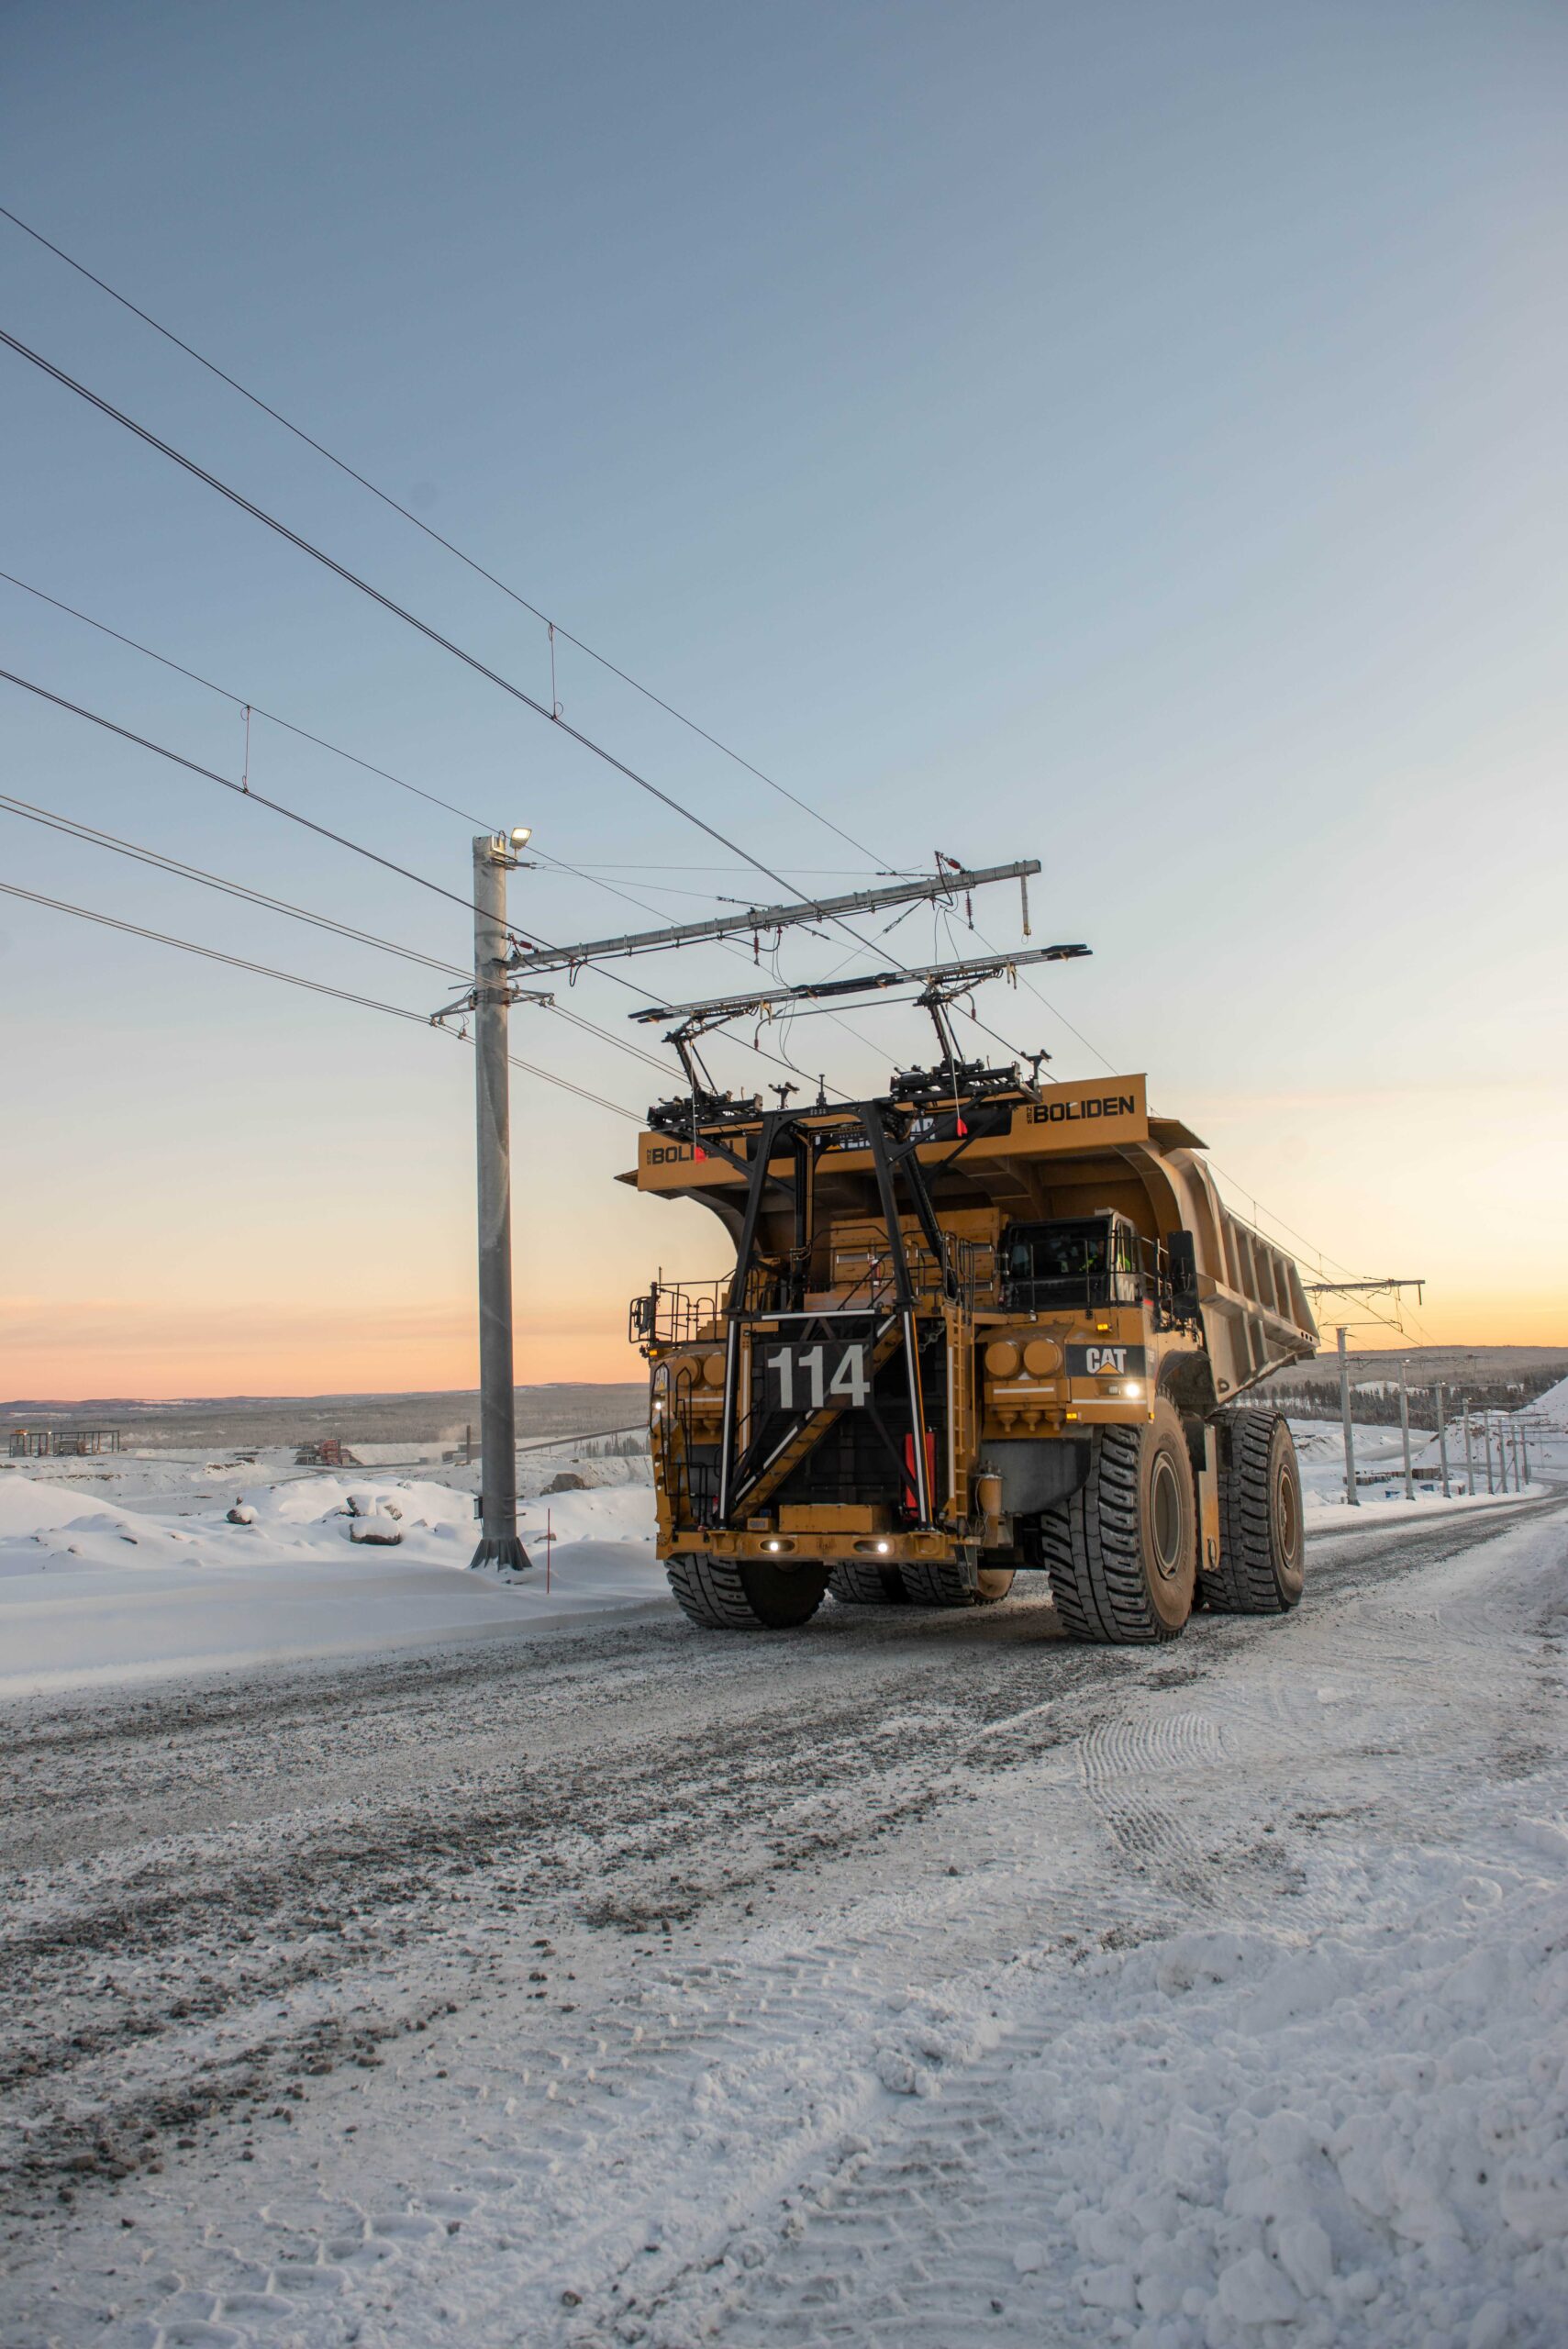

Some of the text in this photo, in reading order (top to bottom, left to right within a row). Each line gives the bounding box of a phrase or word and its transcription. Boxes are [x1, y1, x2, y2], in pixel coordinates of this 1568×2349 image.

[1034, 1096, 1134, 1123] BOLIDEN
[652, 1144, 720, 1165] BOLI
[1086, 1348, 1127, 1374] CAT
[768, 1344, 870, 1408] 114
